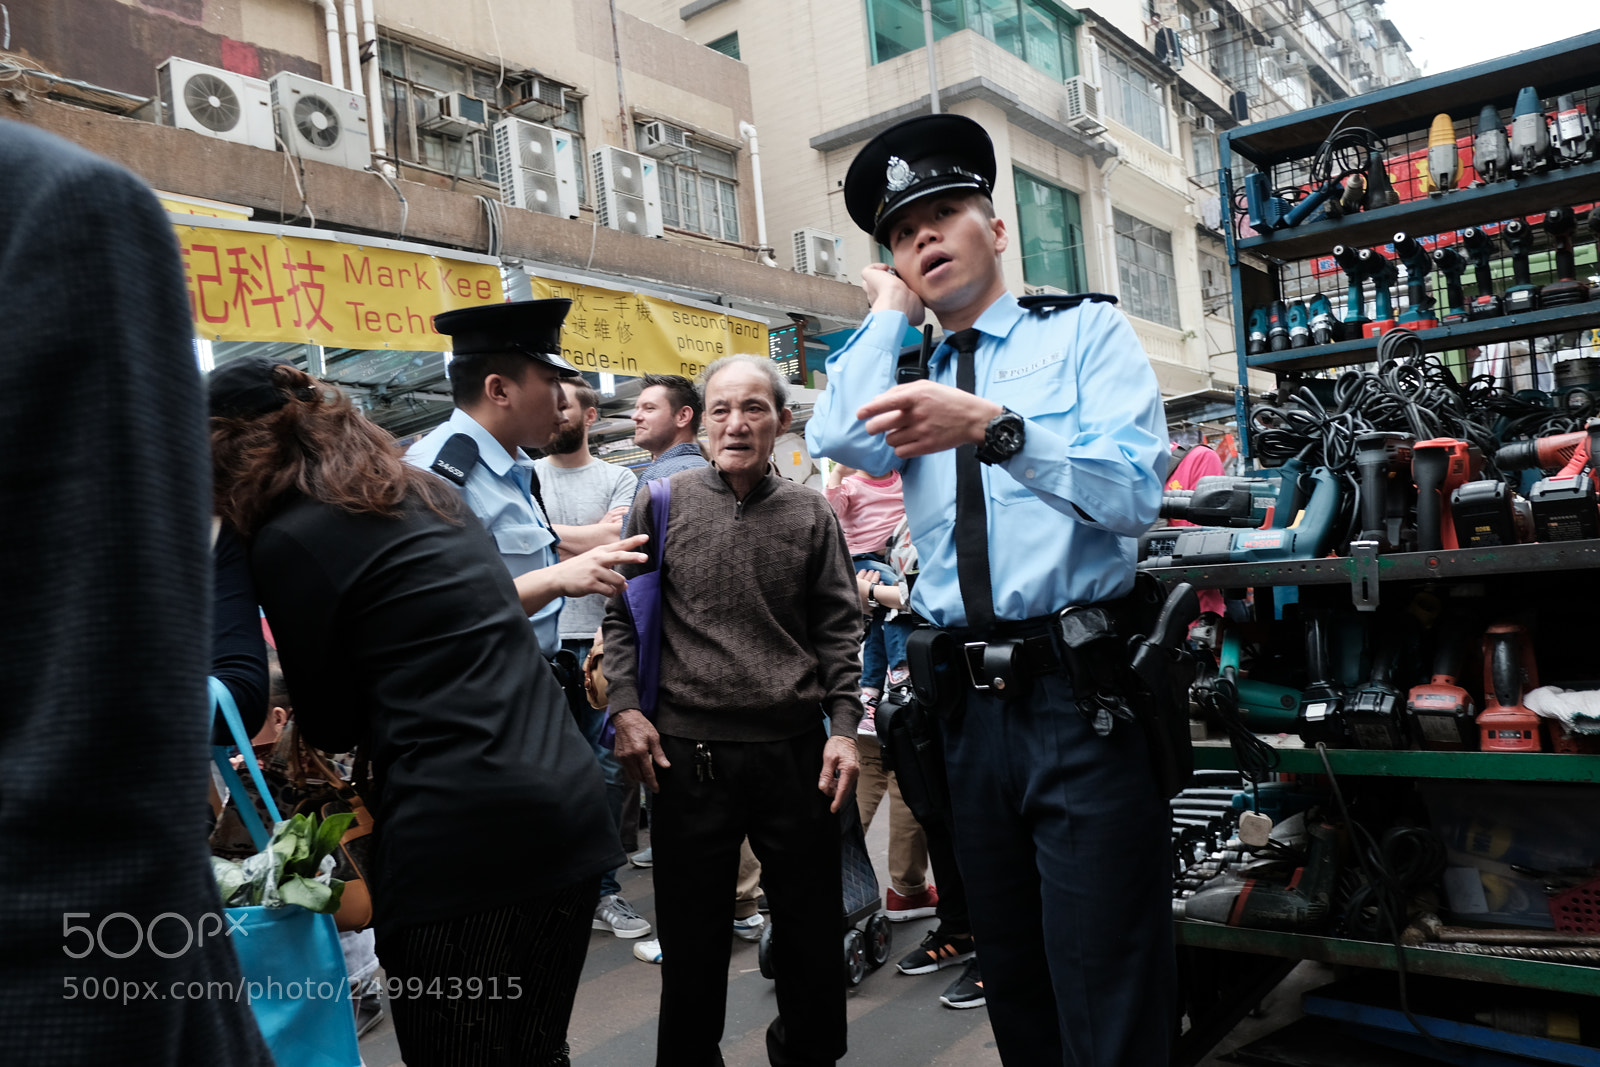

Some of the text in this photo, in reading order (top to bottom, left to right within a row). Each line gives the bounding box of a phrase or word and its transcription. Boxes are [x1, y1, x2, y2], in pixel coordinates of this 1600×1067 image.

[343, 253, 491, 300] Mark Kee
[563, 314, 634, 345] 速維修
[677, 334, 724, 354] phone
[563, 347, 638, 372] rade-in
